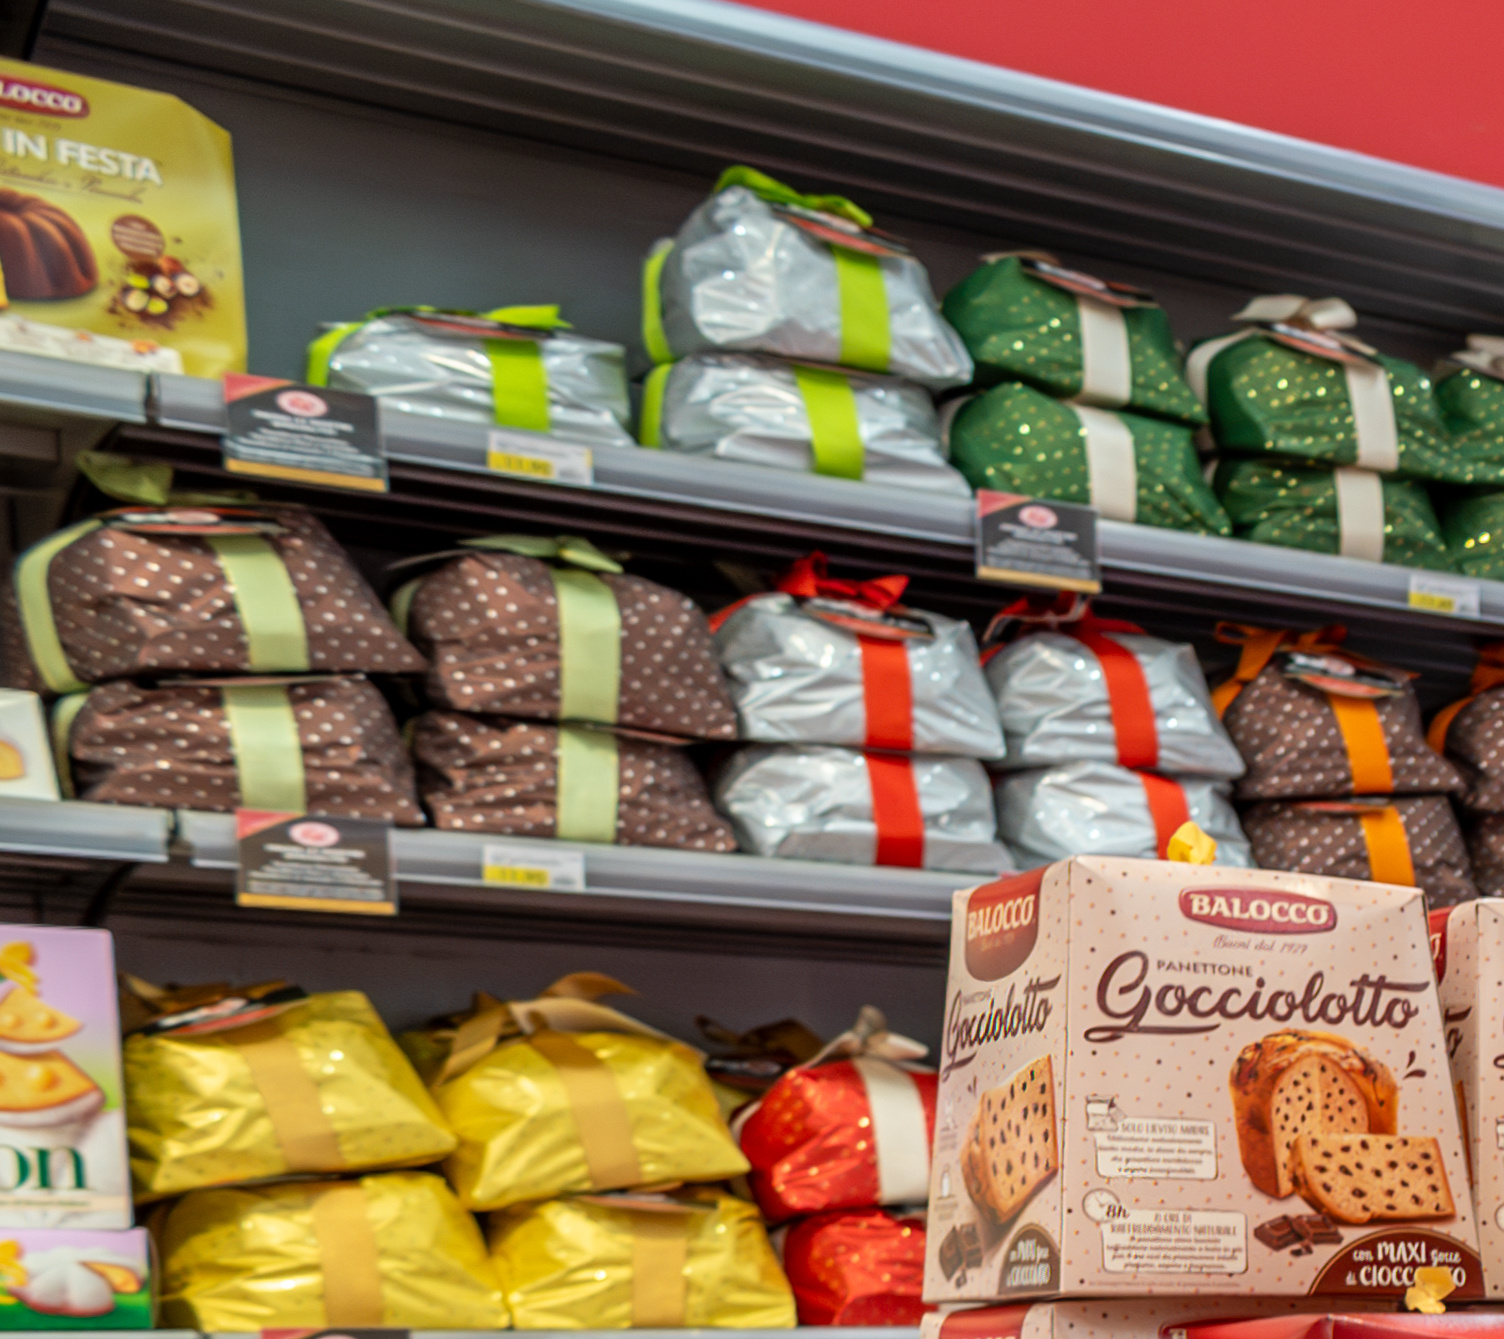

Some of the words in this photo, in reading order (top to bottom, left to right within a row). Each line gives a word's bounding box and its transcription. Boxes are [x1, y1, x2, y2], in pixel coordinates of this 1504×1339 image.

[2, 127, 48, 163] IN
[57, 137, 163, 187] FESTA
[1189, 892, 1329, 925] BALOCCO
[1157, 960, 1253, 977] PANETTONE
[1083, 950, 1430, 1043] Gocciolotto
[1353, 1248, 1374, 1263] con
[1377, 1243, 1426, 1263] MAXI
[1431, 1250, 1461, 1265] gocce
